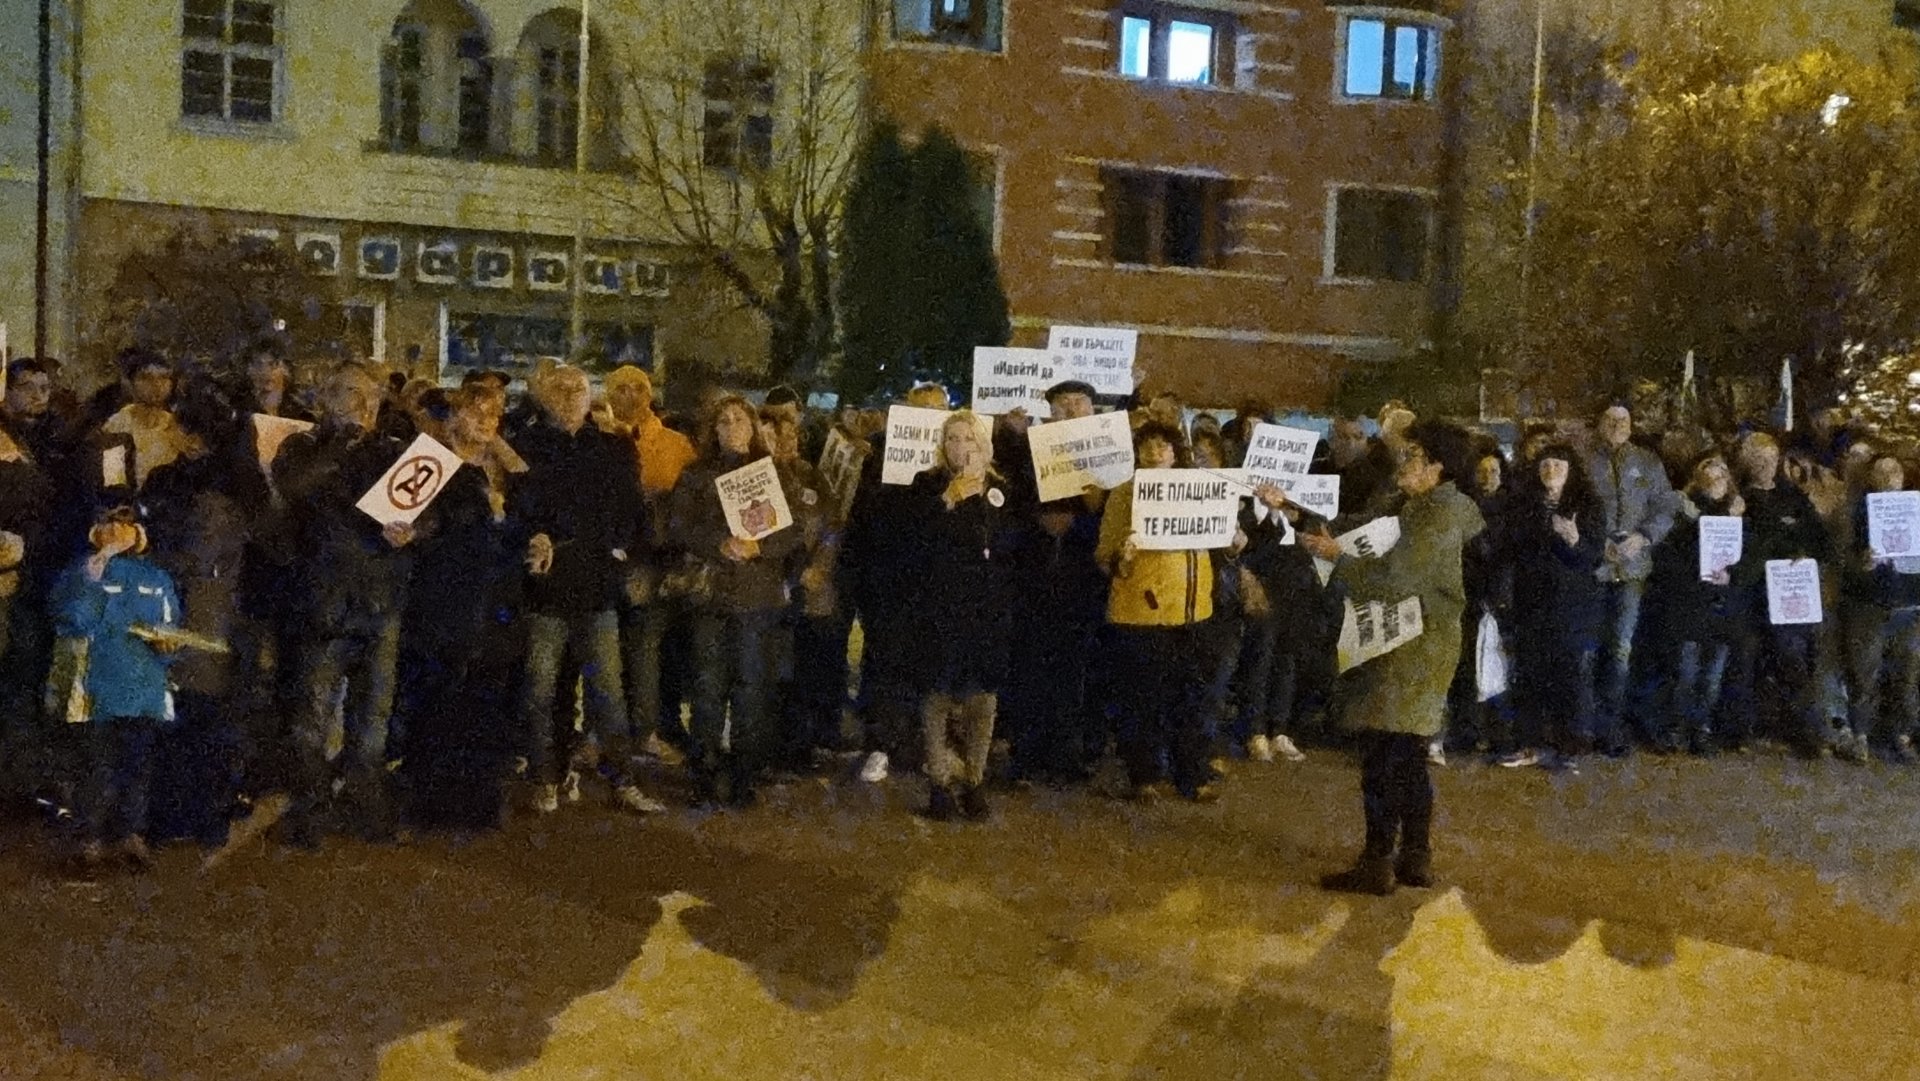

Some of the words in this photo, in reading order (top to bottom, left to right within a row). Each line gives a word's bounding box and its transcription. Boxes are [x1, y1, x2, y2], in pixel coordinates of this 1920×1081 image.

[892, 423, 922, 441] ЗАЕМИ
[924, 428, 930, 441] И
[722, 471, 768, 495] ПРАСЕТО
[1138, 481, 1164, 501] НИЕ
[1167, 481, 1227, 505] ПЛАЩАМЕ
[1143, 516, 1159, 536] ТЕ
[1162, 514, 1228, 536] РЕШАВАТ!!!
